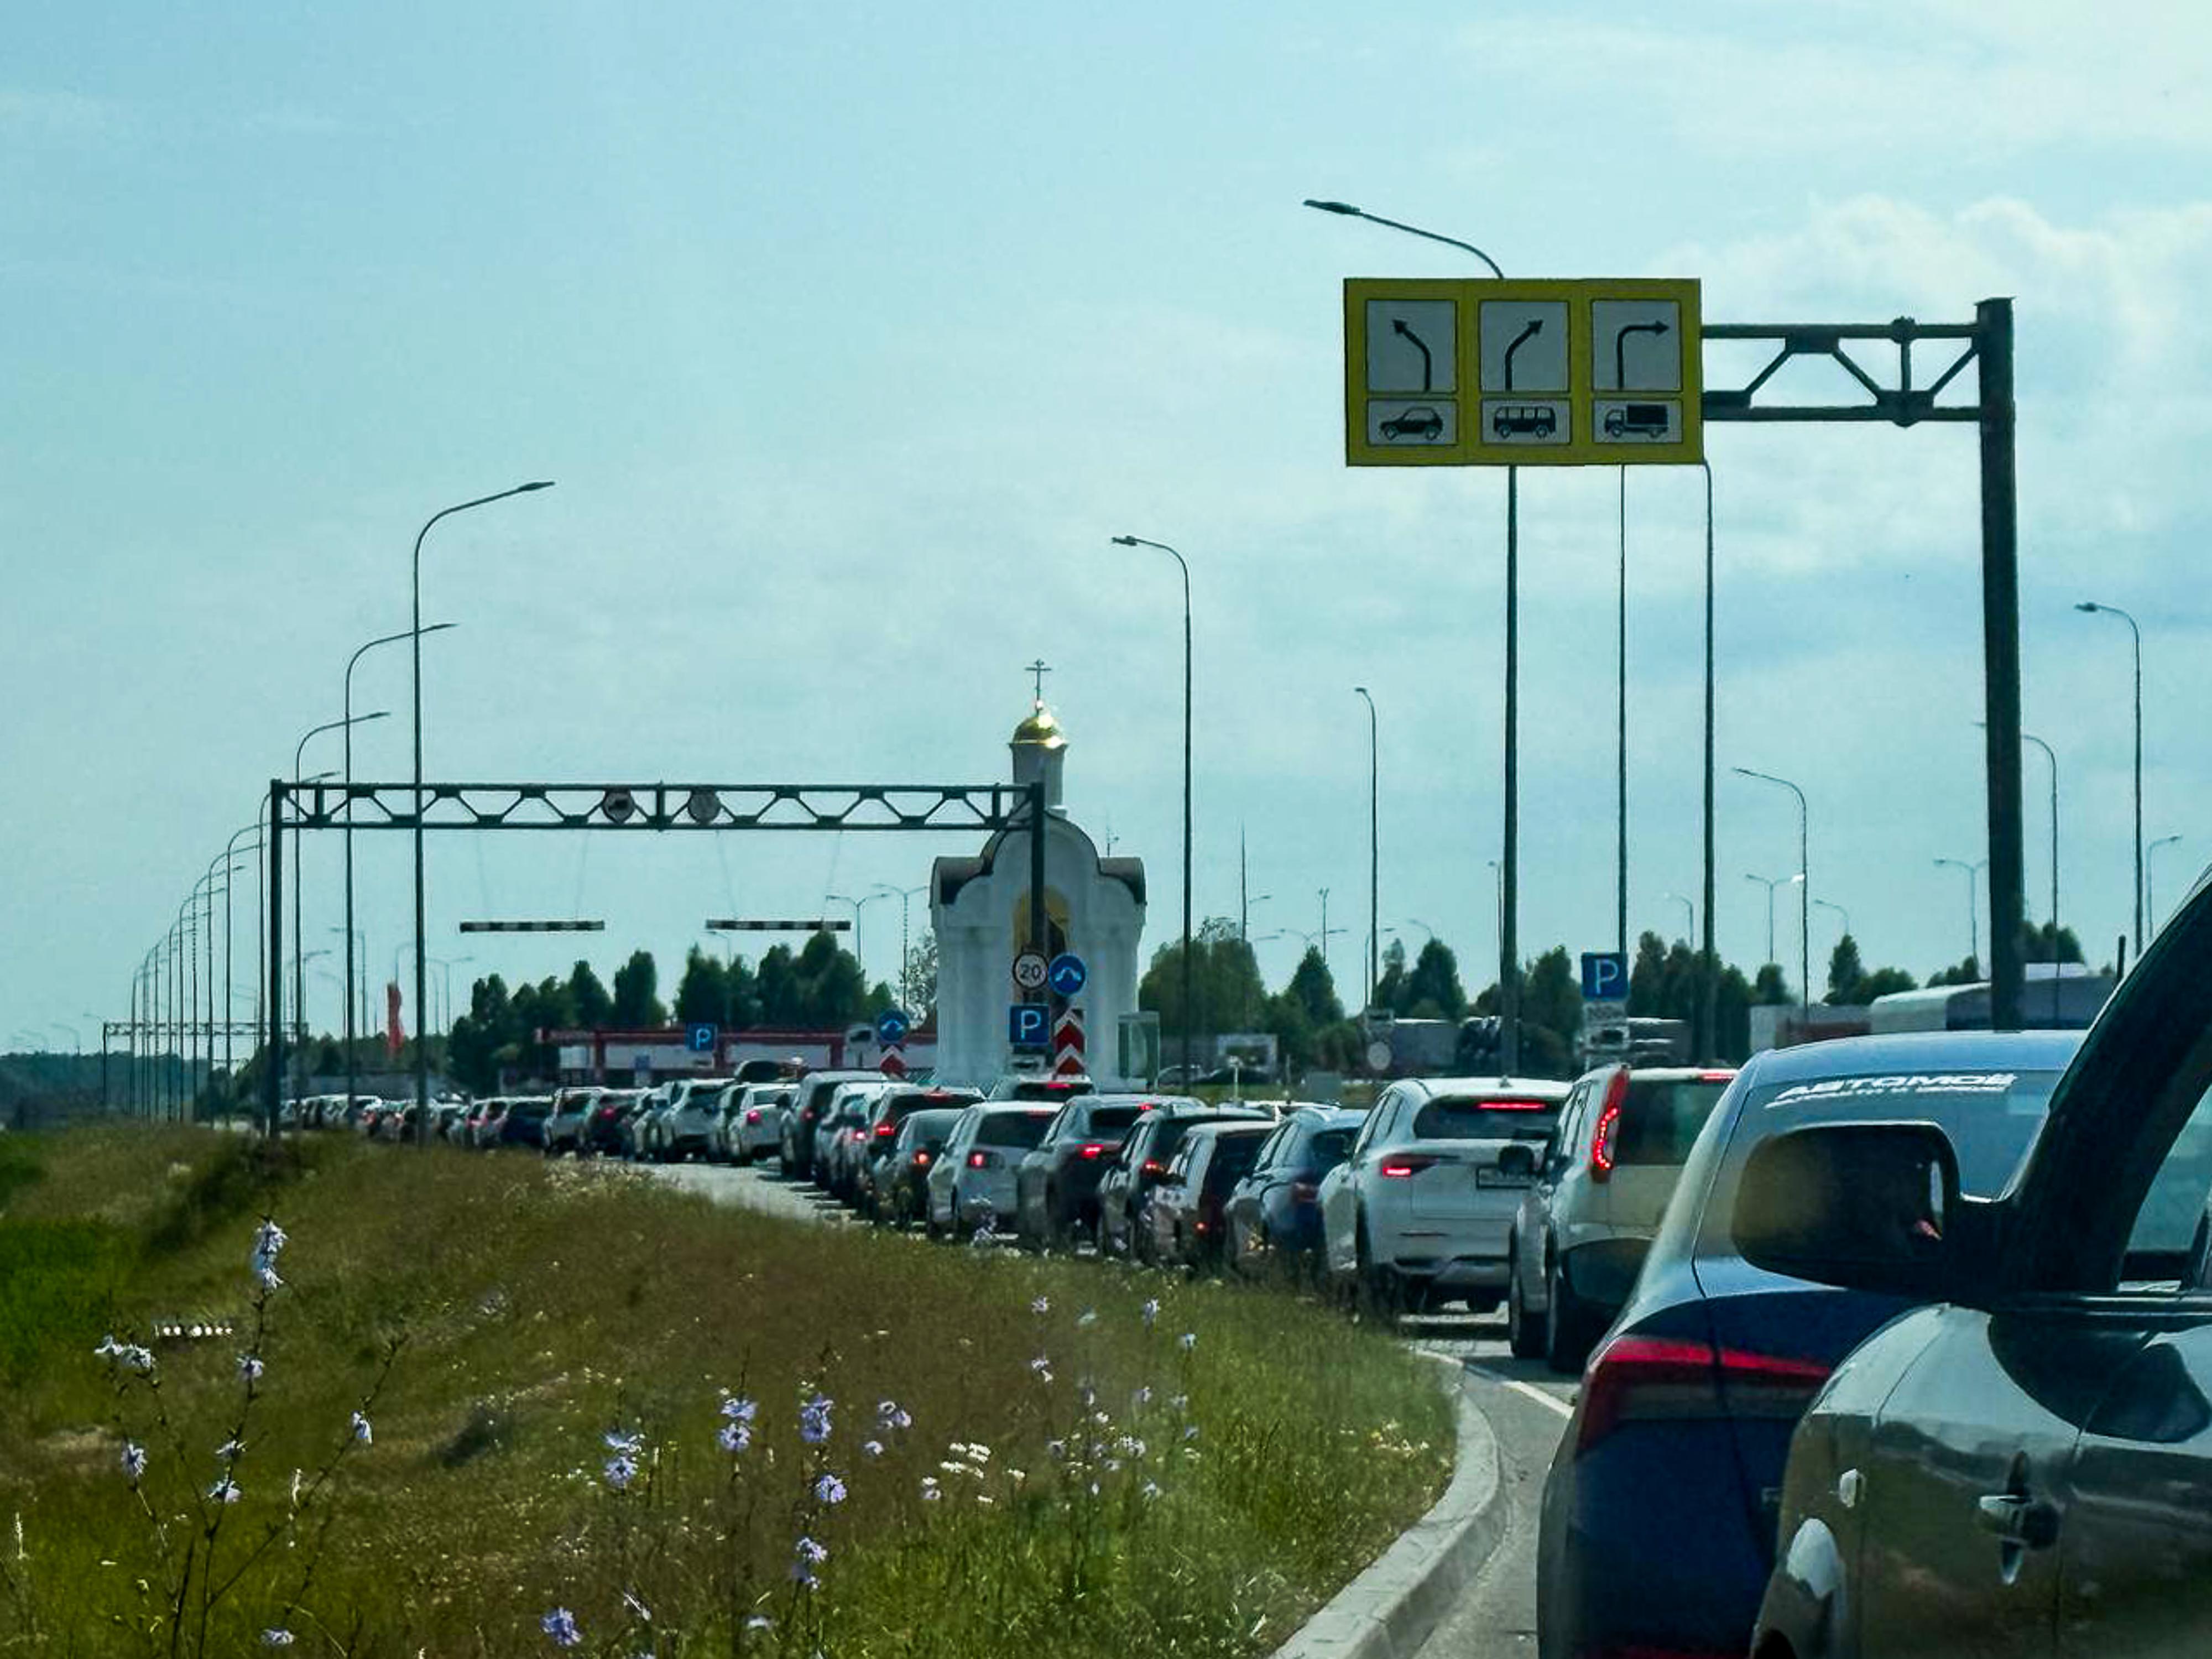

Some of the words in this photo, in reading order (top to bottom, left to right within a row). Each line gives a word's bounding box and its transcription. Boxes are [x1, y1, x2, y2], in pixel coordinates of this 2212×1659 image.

[1020, 964, 1041, 982] 20
[1595, 959, 1619, 994] P
[696, 1027, 712, 1049] P
[1020, 1010, 1042, 1040] P
